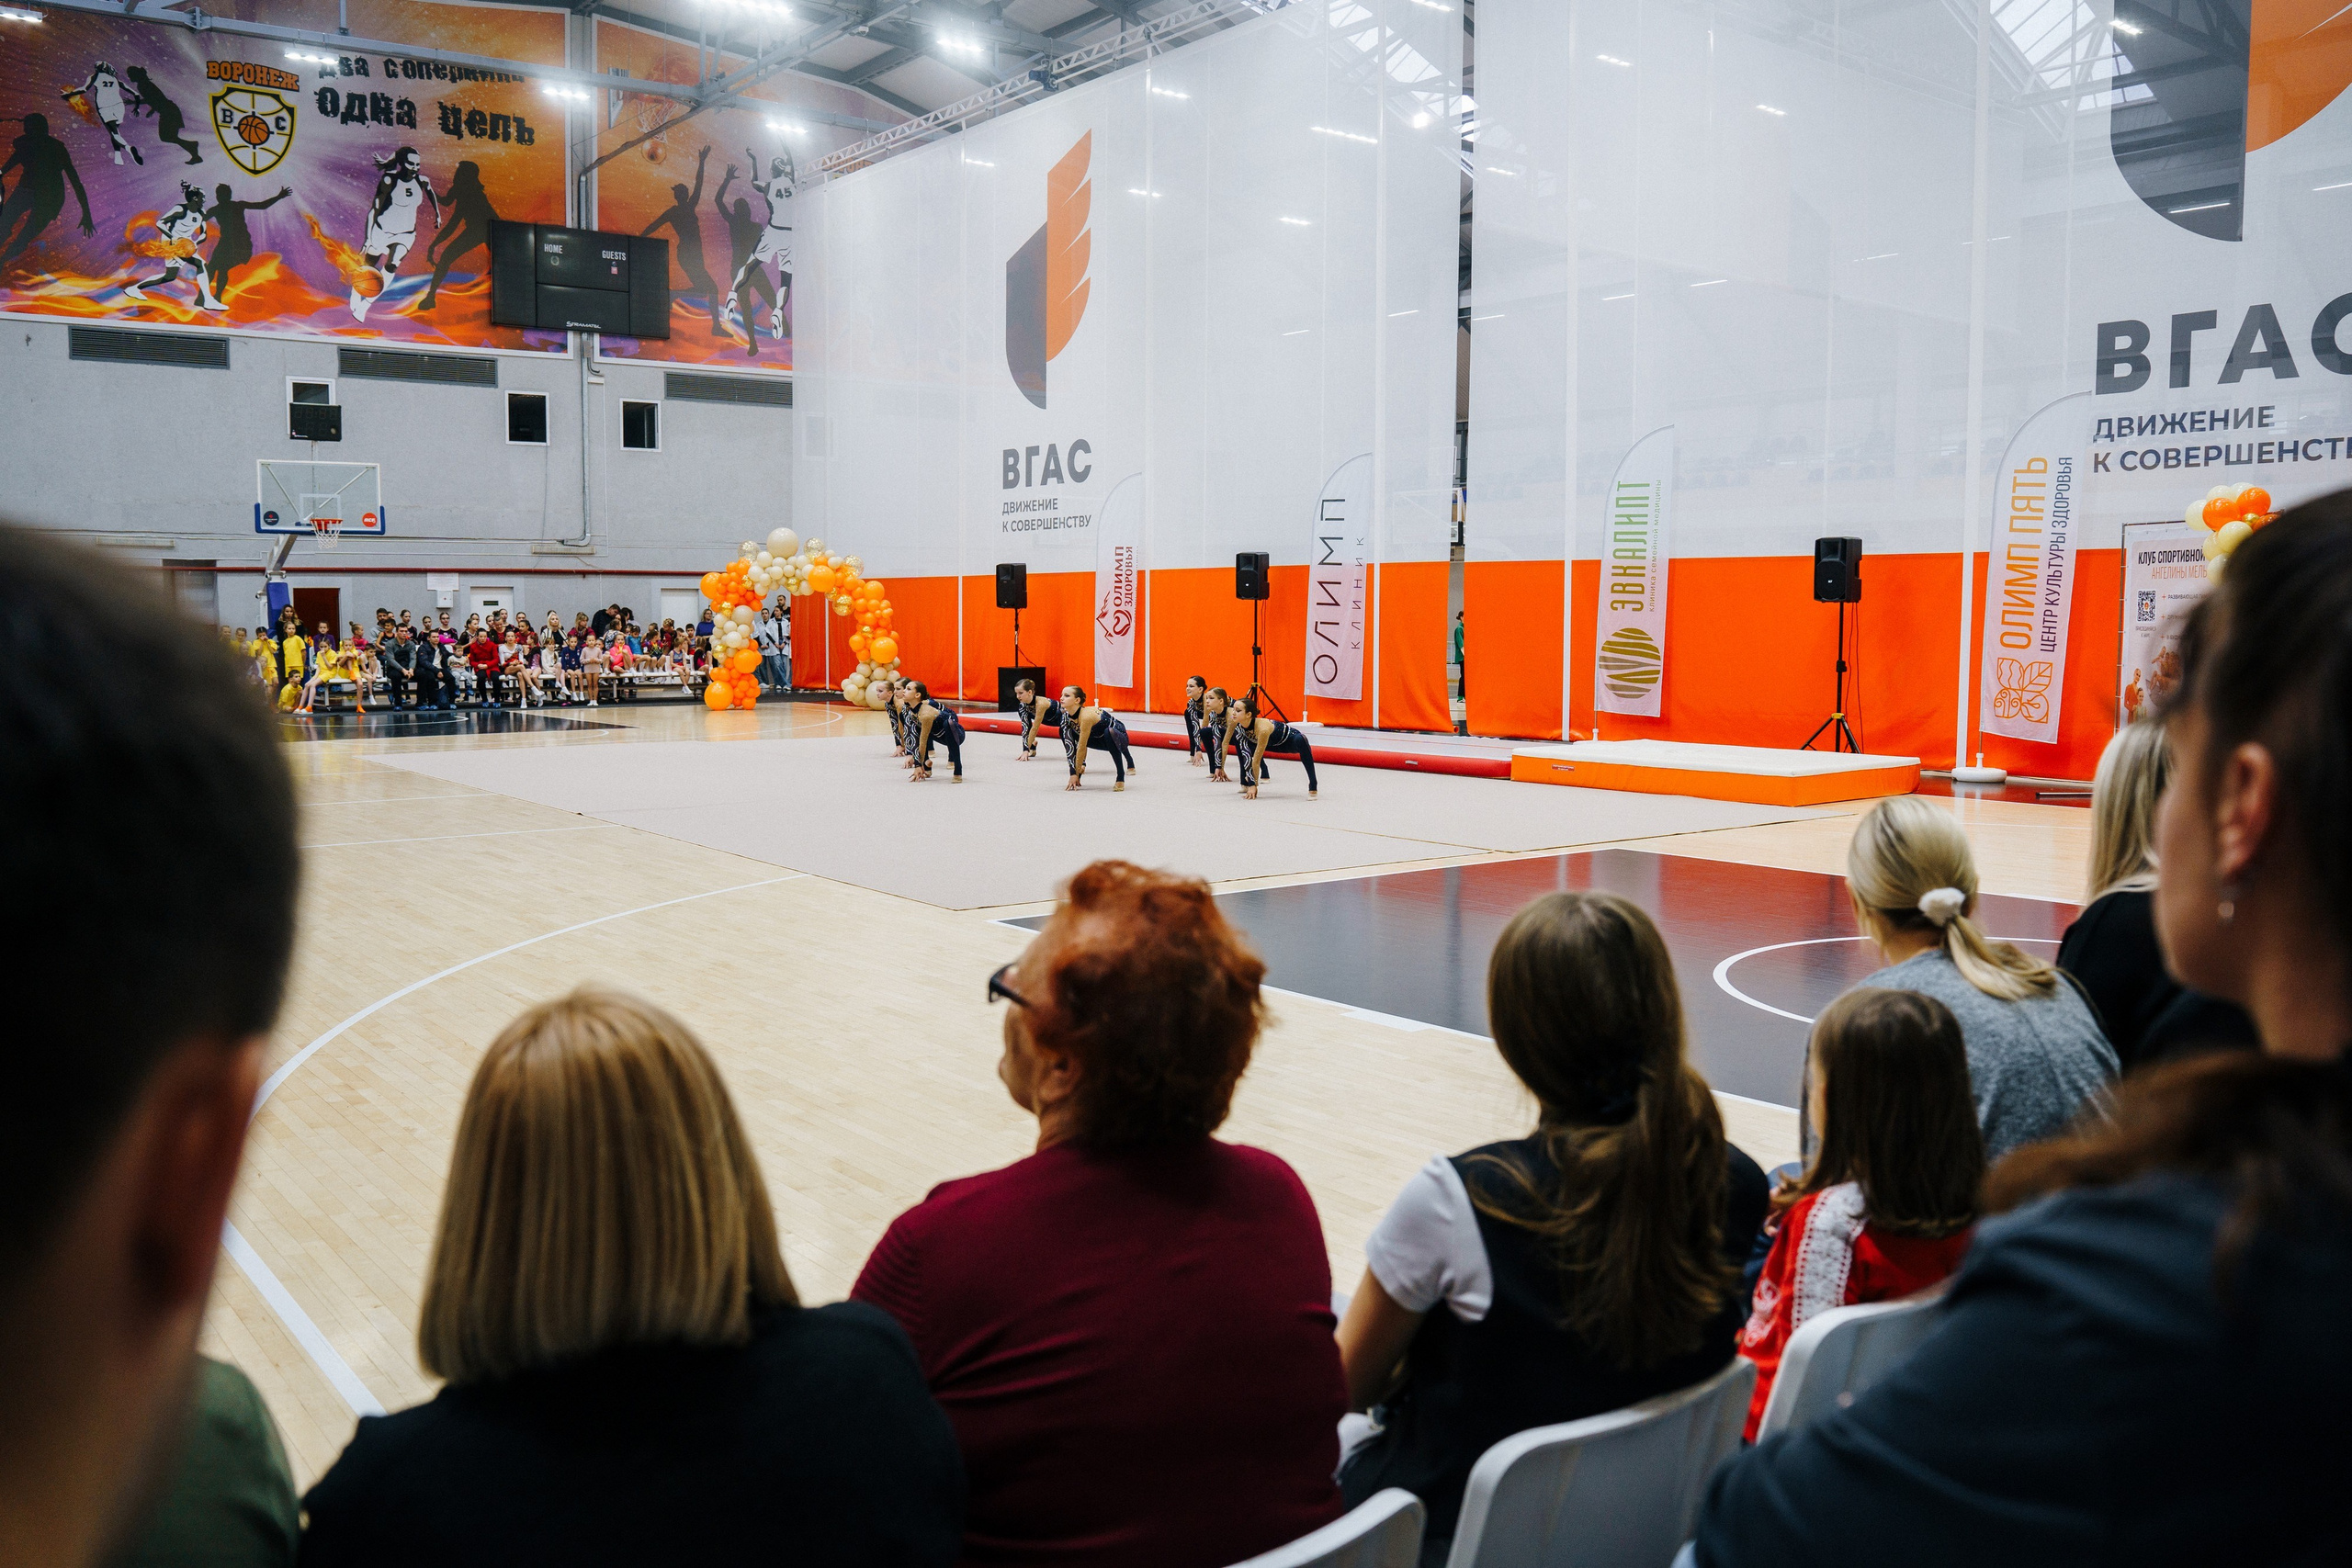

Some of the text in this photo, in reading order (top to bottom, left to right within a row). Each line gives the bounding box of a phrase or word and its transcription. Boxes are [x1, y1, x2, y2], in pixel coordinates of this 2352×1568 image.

[207, 61, 300, 92] ВОРОНЕЖ
[405, 188, 413, 197] 5
[775, 187, 793, 199] 45
[544, 243, 563, 254] HOME
[602, 250, 627, 261] GUESTS
[2093, 405, 2275, 443] ДВИЖЕНИЕ
[1002, 438, 1092, 490] ВГАС
[2093, 451, 2111, 473] К
[1002, 498, 1058, 515] ДВИЖЕНИЕ
[1002, 514, 1091, 533] К СОВЕРШЕНСТВУ
[1610, 480, 1650, 612] ЭВКАЛИПТ
[2000, 457, 2048, 649] ОЛИМП ПЯТЬ
[2040, 457, 2073, 652] ЦЕНТР КУЛЬТУРЫ ЗДОРОВЬЯ
[2138, 551, 2156, 566] КЛУБ
[1113, 546, 1124, 607] ОЛИМП
[1125, 546, 1134, 606] ЗДОРОВЬЯ
[2152, 564, 2208, 580] АНГЕЛИНЫ МЕЛЬ
[1313, 499, 1346, 684] ОЛИМП
[1351, 537, 1364, 649] КЛИНИК
